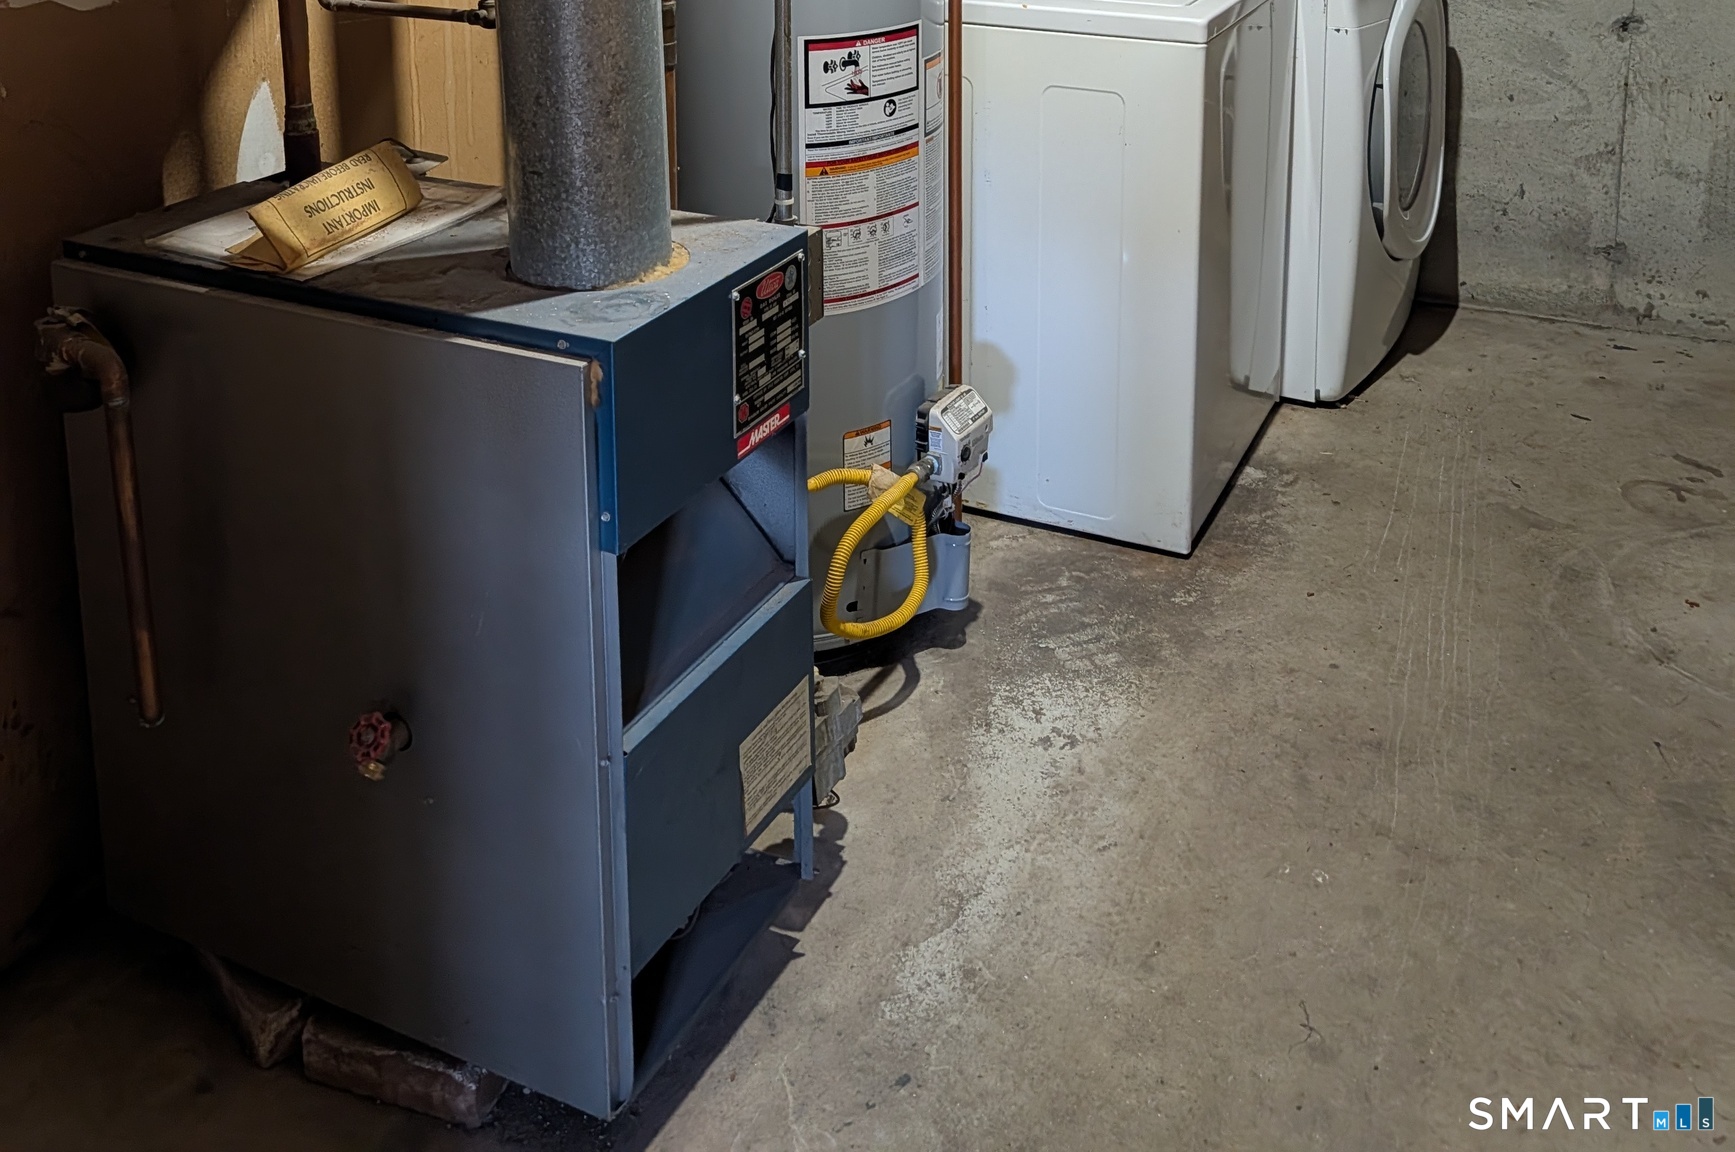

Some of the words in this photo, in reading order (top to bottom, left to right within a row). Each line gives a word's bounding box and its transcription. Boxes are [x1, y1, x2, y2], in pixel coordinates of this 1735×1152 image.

[862, 36, 886, 46] DANGER
[318, 162, 351, 181] BEFORE
[348, 153, 373, 168] READ
[303, 177, 376, 219] INSTRUCTIONS
[321, 199, 381, 236] IMPORTANT
[748, 412, 781, 446] MASTER
